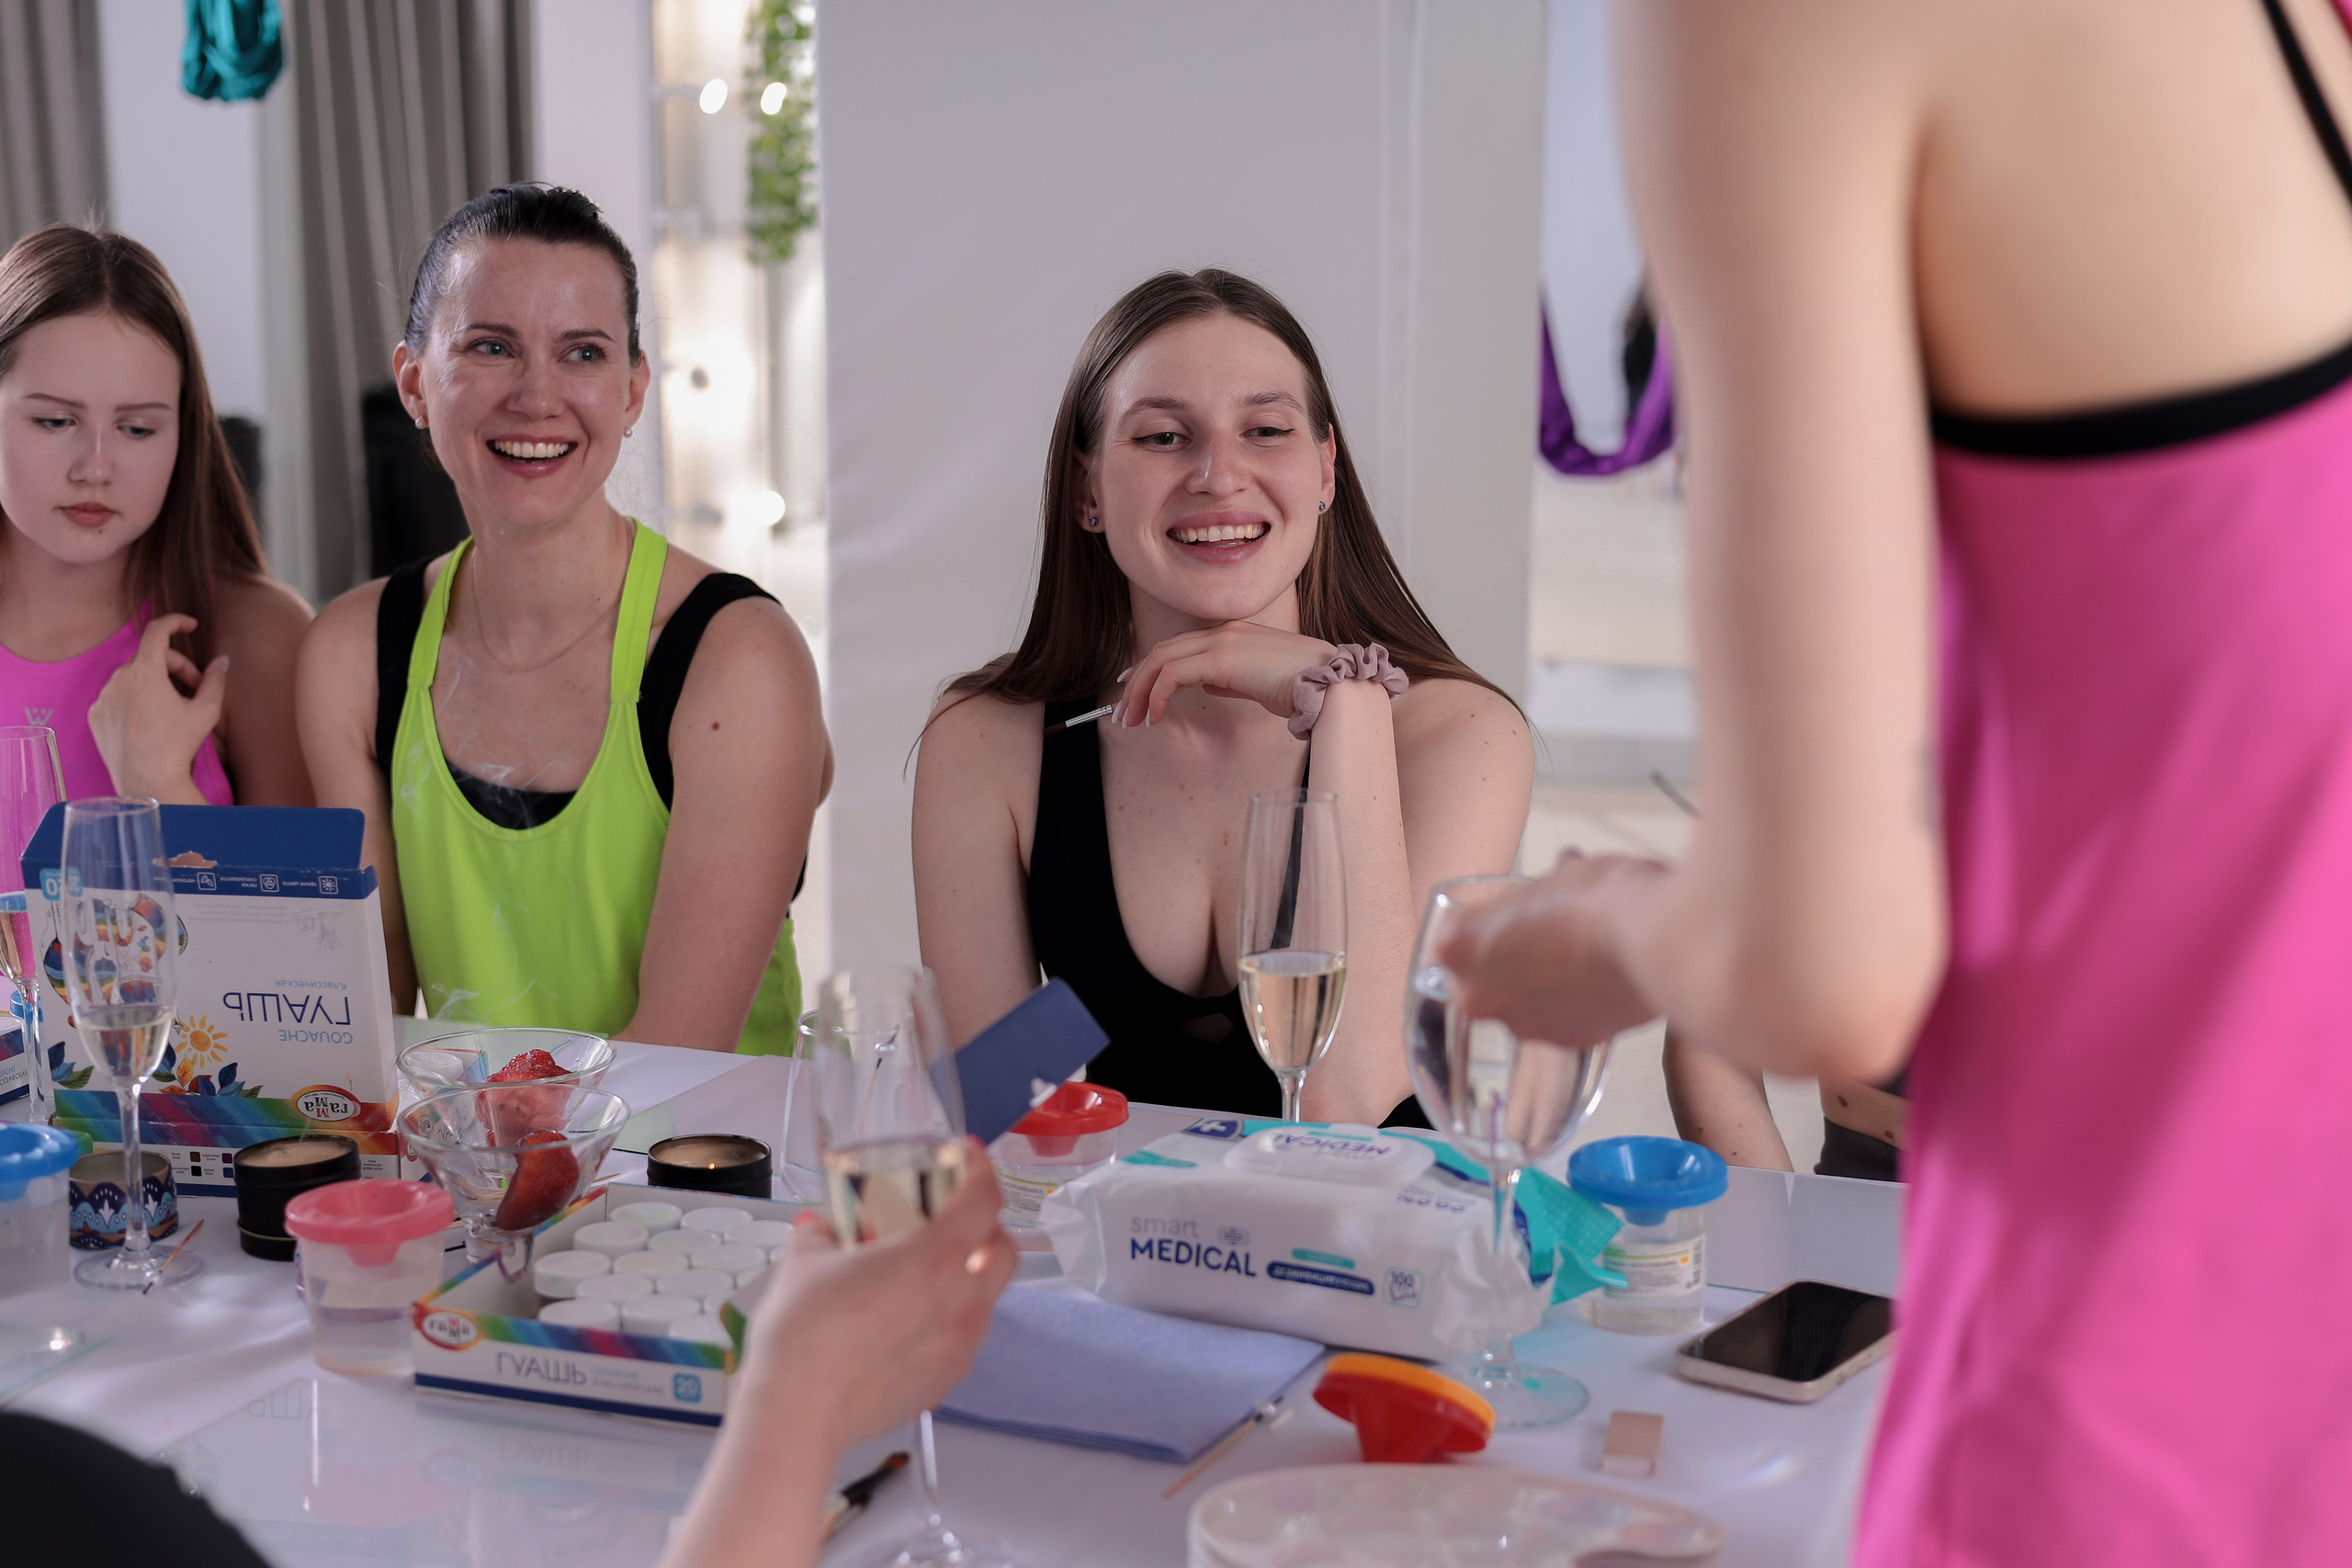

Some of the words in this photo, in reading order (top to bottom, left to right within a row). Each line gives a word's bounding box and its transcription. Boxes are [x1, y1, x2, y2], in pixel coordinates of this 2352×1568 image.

[275, 979, 347, 991] Классическая
[222, 992, 351, 1026] ГУАШЬ
[277, 1029, 354, 1044] GOUACHE
[1130, 1215, 1199, 1238] smart
[1130, 1236, 1257, 1278] MEDICAL
[1390, 1270, 1415, 1288] 100
[496, 1350, 587, 1386] ГУАШЬ
[676, 1374, 698, 1394] 20
